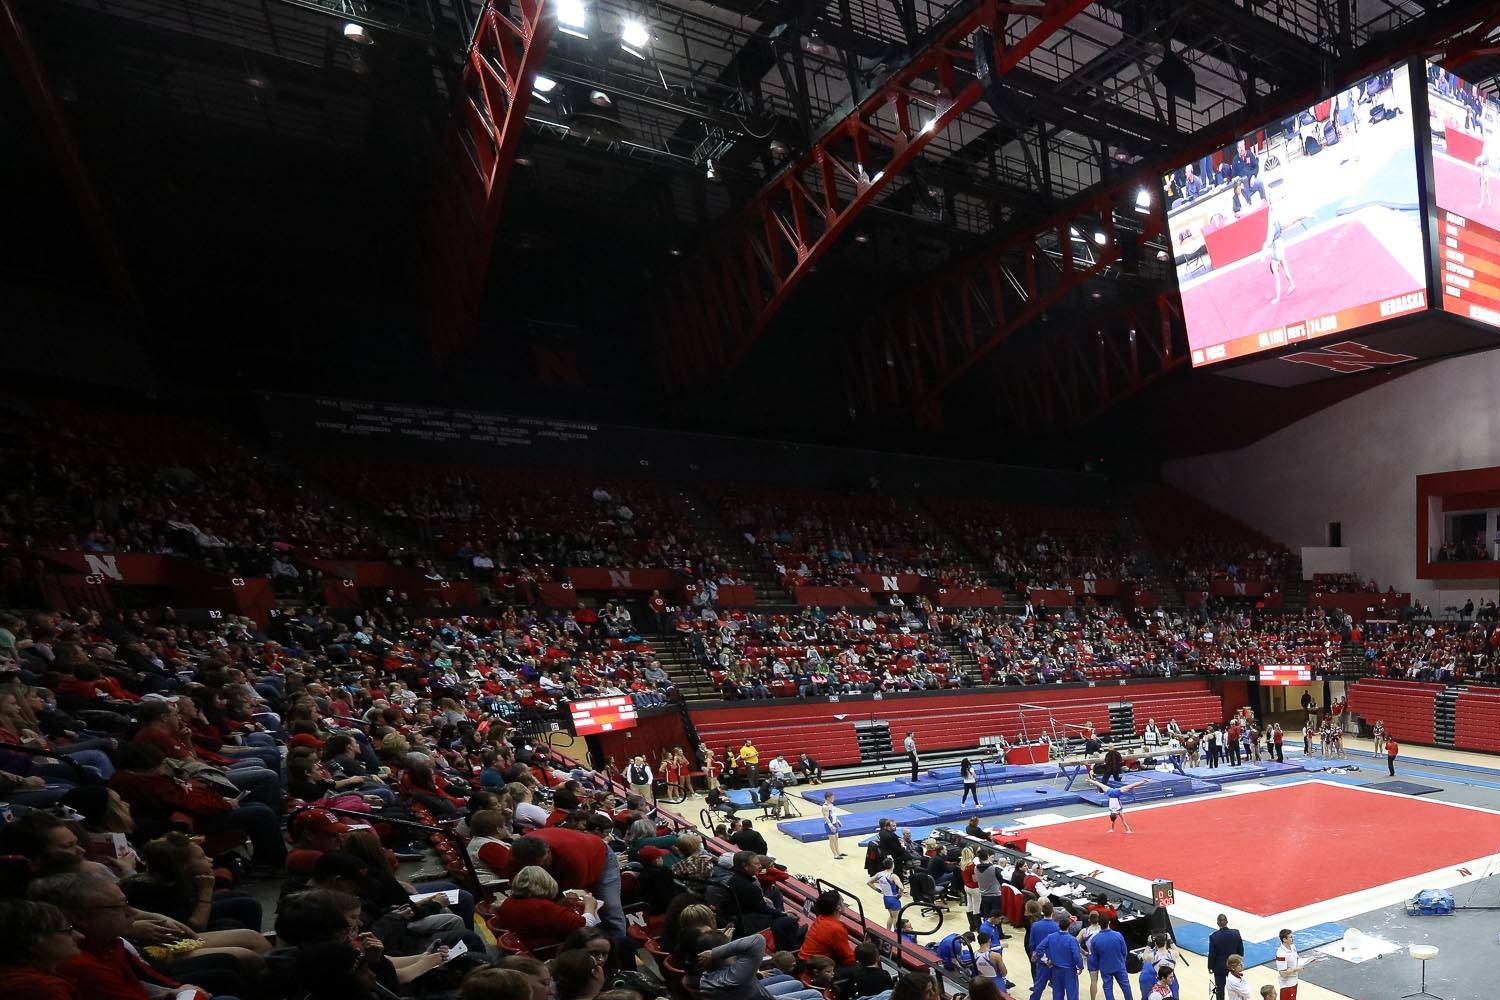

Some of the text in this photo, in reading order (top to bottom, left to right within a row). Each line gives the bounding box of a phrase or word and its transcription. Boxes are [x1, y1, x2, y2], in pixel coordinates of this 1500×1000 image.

[1379, 292, 1425, 316] NEBRASKA
[84, 554, 123, 581] N
[232, 578, 245, 586] C3
[608, 570, 632, 588] N
[881, 576, 899, 591] N
[210, 610, 223, 619] B2
[625, 911, 647, 927] N
